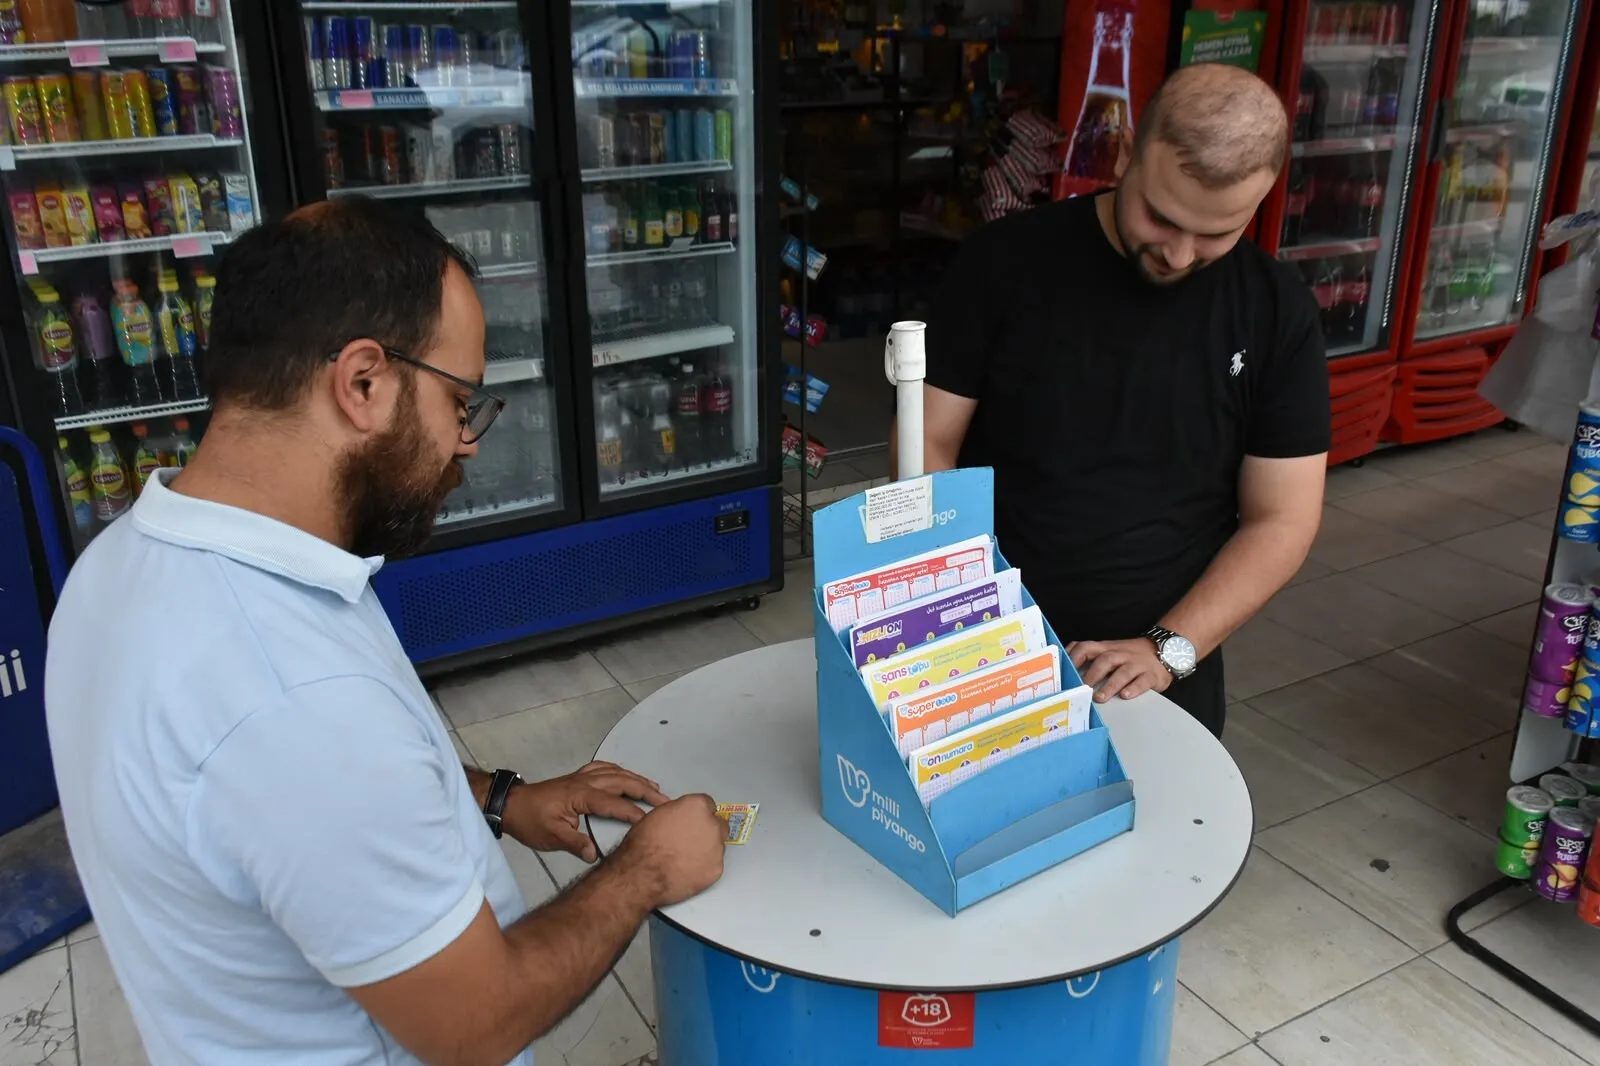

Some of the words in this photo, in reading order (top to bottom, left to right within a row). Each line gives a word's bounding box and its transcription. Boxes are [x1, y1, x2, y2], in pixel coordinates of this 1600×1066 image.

[95, 474, 121, 483] Lipton
[872, 790, 900, 819] milli
[871, 805, 926, 853] piyango
[910, 1002, 941, 1016] +18
